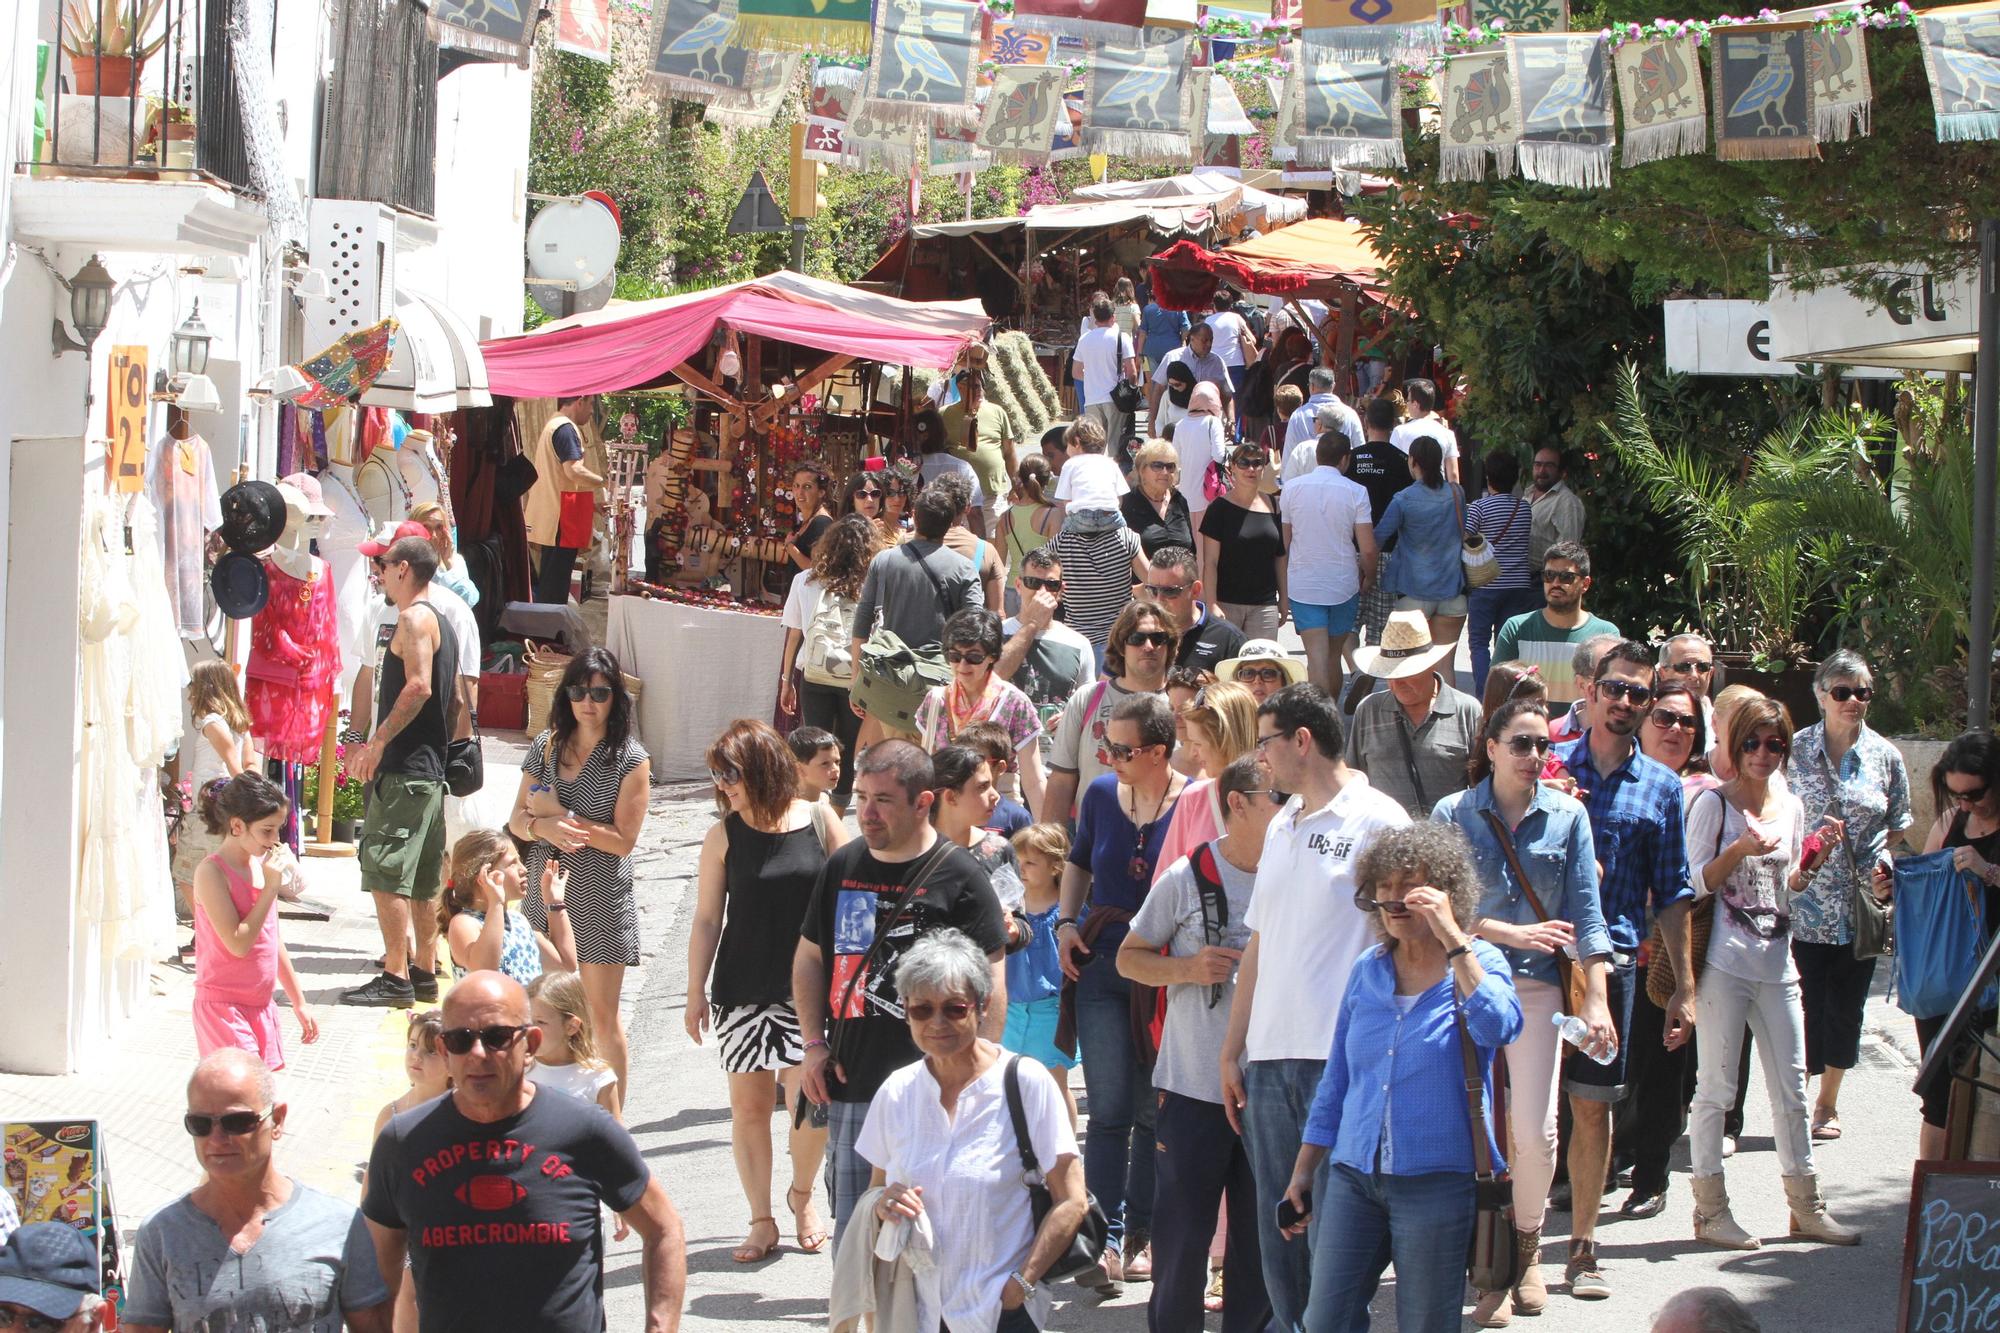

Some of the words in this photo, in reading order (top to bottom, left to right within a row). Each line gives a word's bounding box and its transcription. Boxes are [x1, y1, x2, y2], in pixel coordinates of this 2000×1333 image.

[1386, 650, 1407, 658] IBIZA
[411, 1139, 537, 1188] PROPERTY
[539, 1153, 574, 1181] OF
[420, 1221, 573, 1248] ABERCROMBIE
